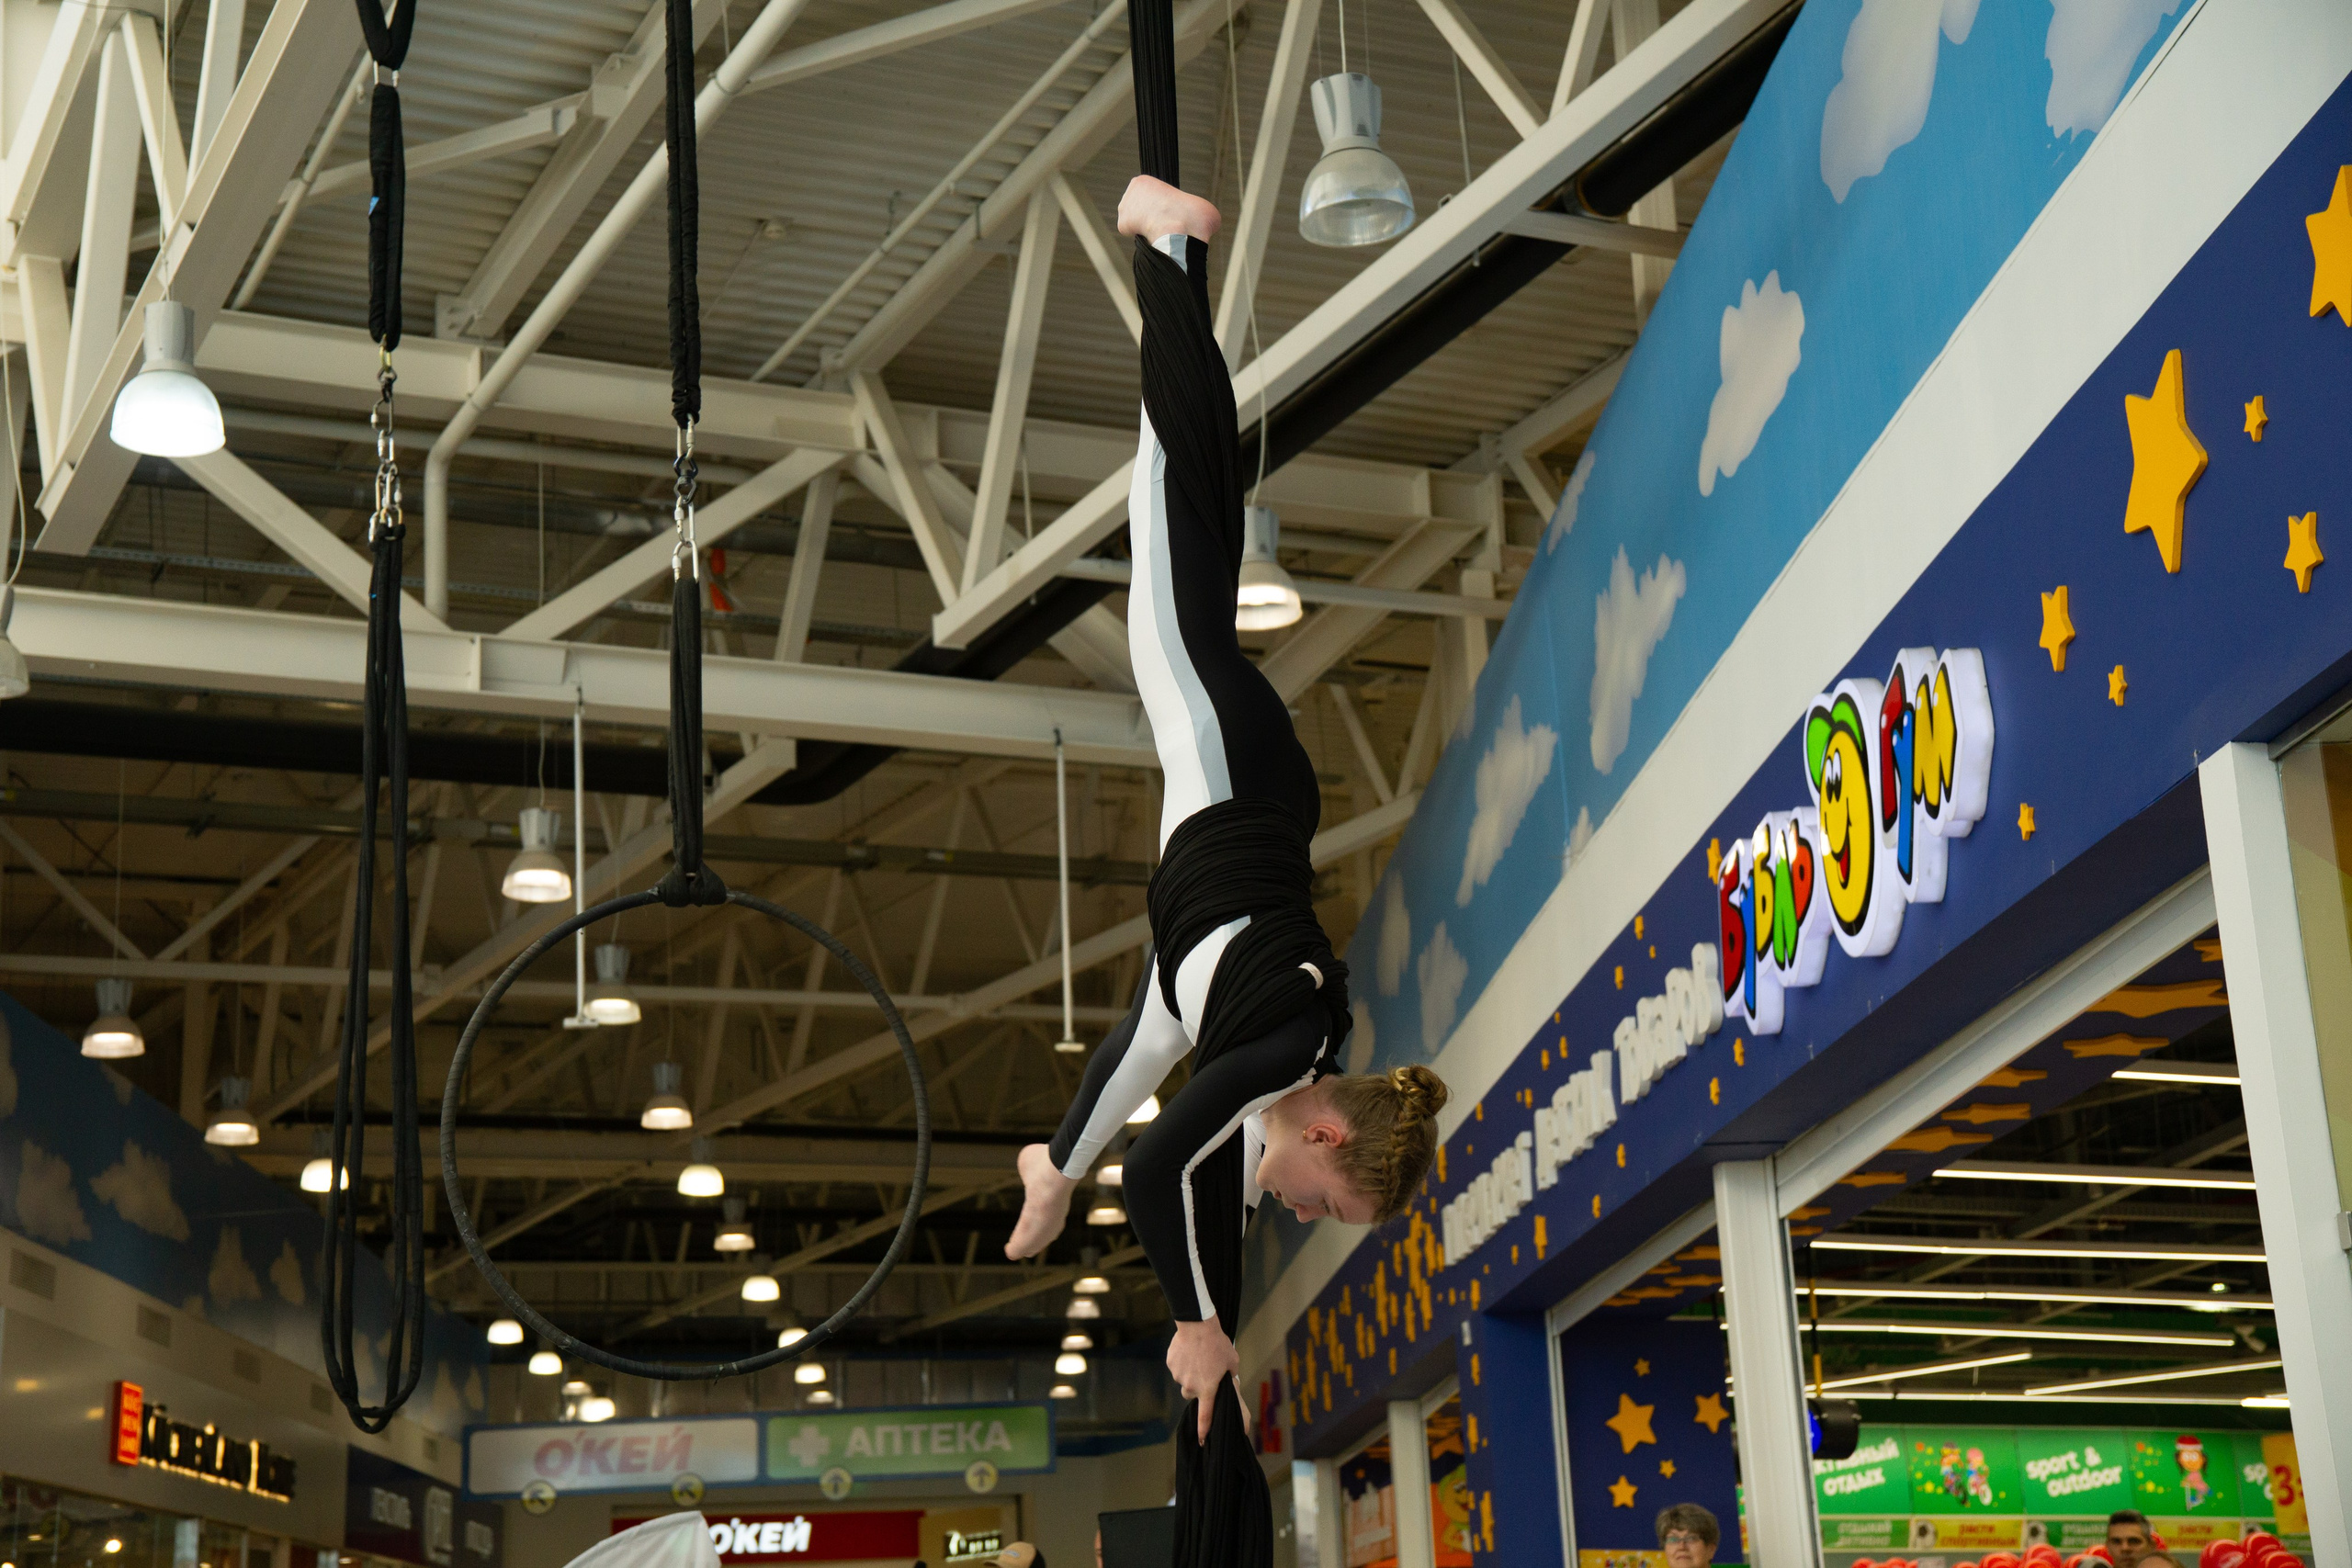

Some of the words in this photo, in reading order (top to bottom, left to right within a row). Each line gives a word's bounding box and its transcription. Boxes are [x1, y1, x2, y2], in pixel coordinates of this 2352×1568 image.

[534, 1426, 694, 1478] О'КЕЙ
[845, 1420, 1012, 1459] АПТЕКА
[2026, 1450, 2081, 1483] sport
[2085, 1446, 2102, 1467] &
[2047, 1465, 2122, 1497] outdoor
[708, 1516, 812, 1555] О'КЕЙ
